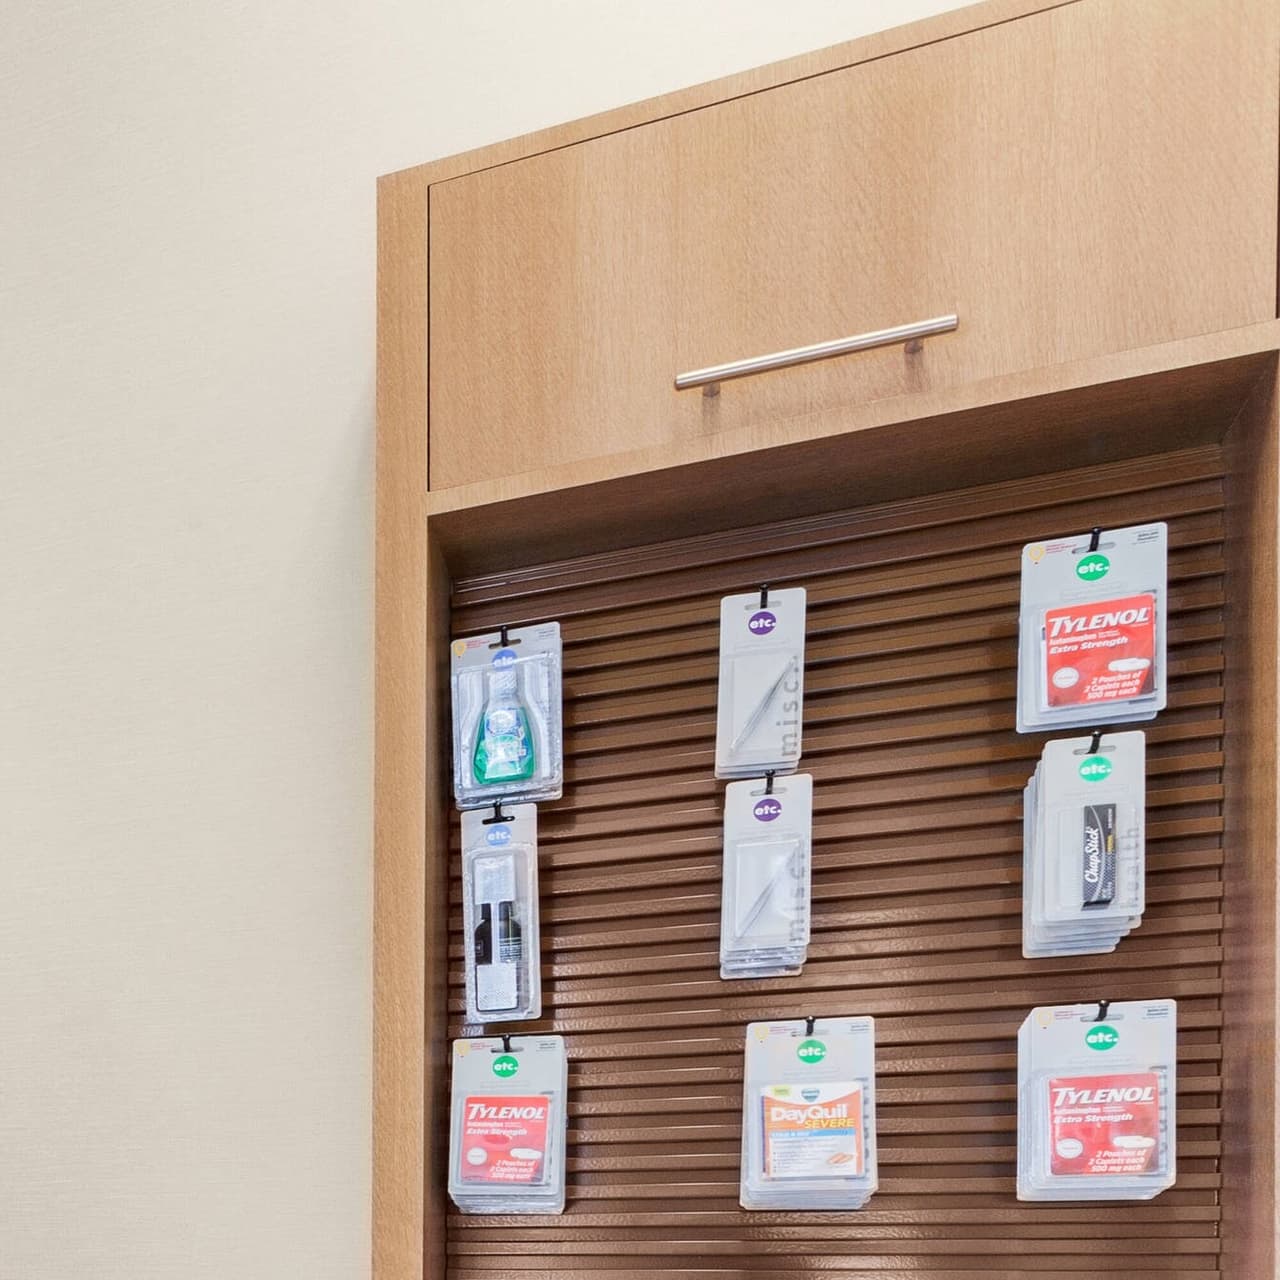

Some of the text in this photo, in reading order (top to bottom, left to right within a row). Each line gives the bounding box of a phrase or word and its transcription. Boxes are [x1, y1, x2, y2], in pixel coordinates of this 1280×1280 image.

[1077, 560, 1110, 575] etc.
[749, 618, 777, 630] etc.
[1048, 607, 1151, 638] TYLENOL
[1049, 642, 1079, 655] Extra
[1080, 635, 1129, 651] Strength
[1099, 672, 1129, 685] Pouches
[1079, 763, 1113, 776] etc.
[754, 805, 782, 817] etc.
[486, 830, 512, 843] etc.
[1084, 825, 1100, 884] ChapStick
[1086, 1031, 1119, 1043] etc.
[798, 1046, 826, 1057] etc.
[493, 1061, 519, 1073] etc.
[1052, 1086, 1156, 1107] TYLENOL
[467, 1103, 545, 1121] TYLENOL
[770, 1104, 849, 1124] DayQuil
[1053, 1112, 1134, 1125] Extra Strength
[804, 1118, 855, 1129] SEVERE
